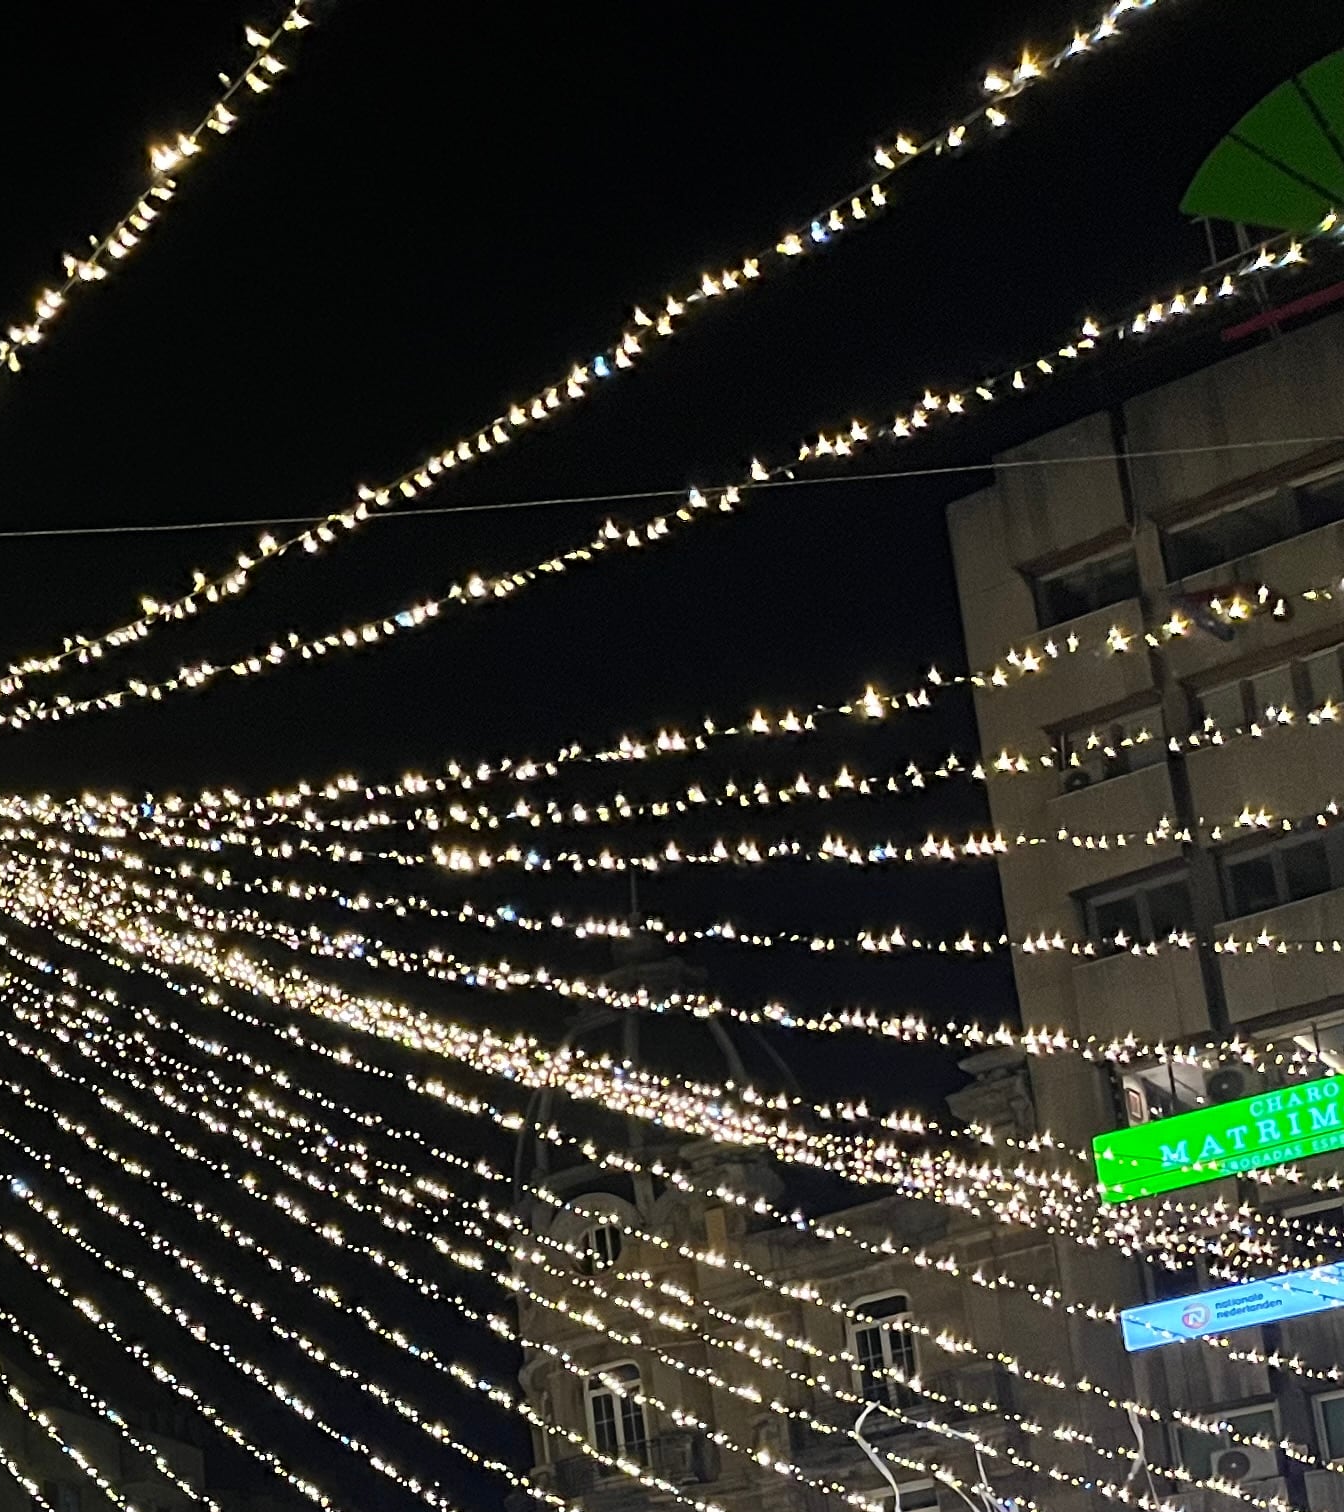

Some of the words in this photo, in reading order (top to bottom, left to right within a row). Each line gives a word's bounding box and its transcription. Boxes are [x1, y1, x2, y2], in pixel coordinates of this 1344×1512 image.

[1249, 1082, 1340, 1117] CHARO
[1160, 1103, 1344, 1168] MATRIM
[1215, 1293, 1264, 1310] nationale
[1216, 1299, 1283, 1319] nederlanden
